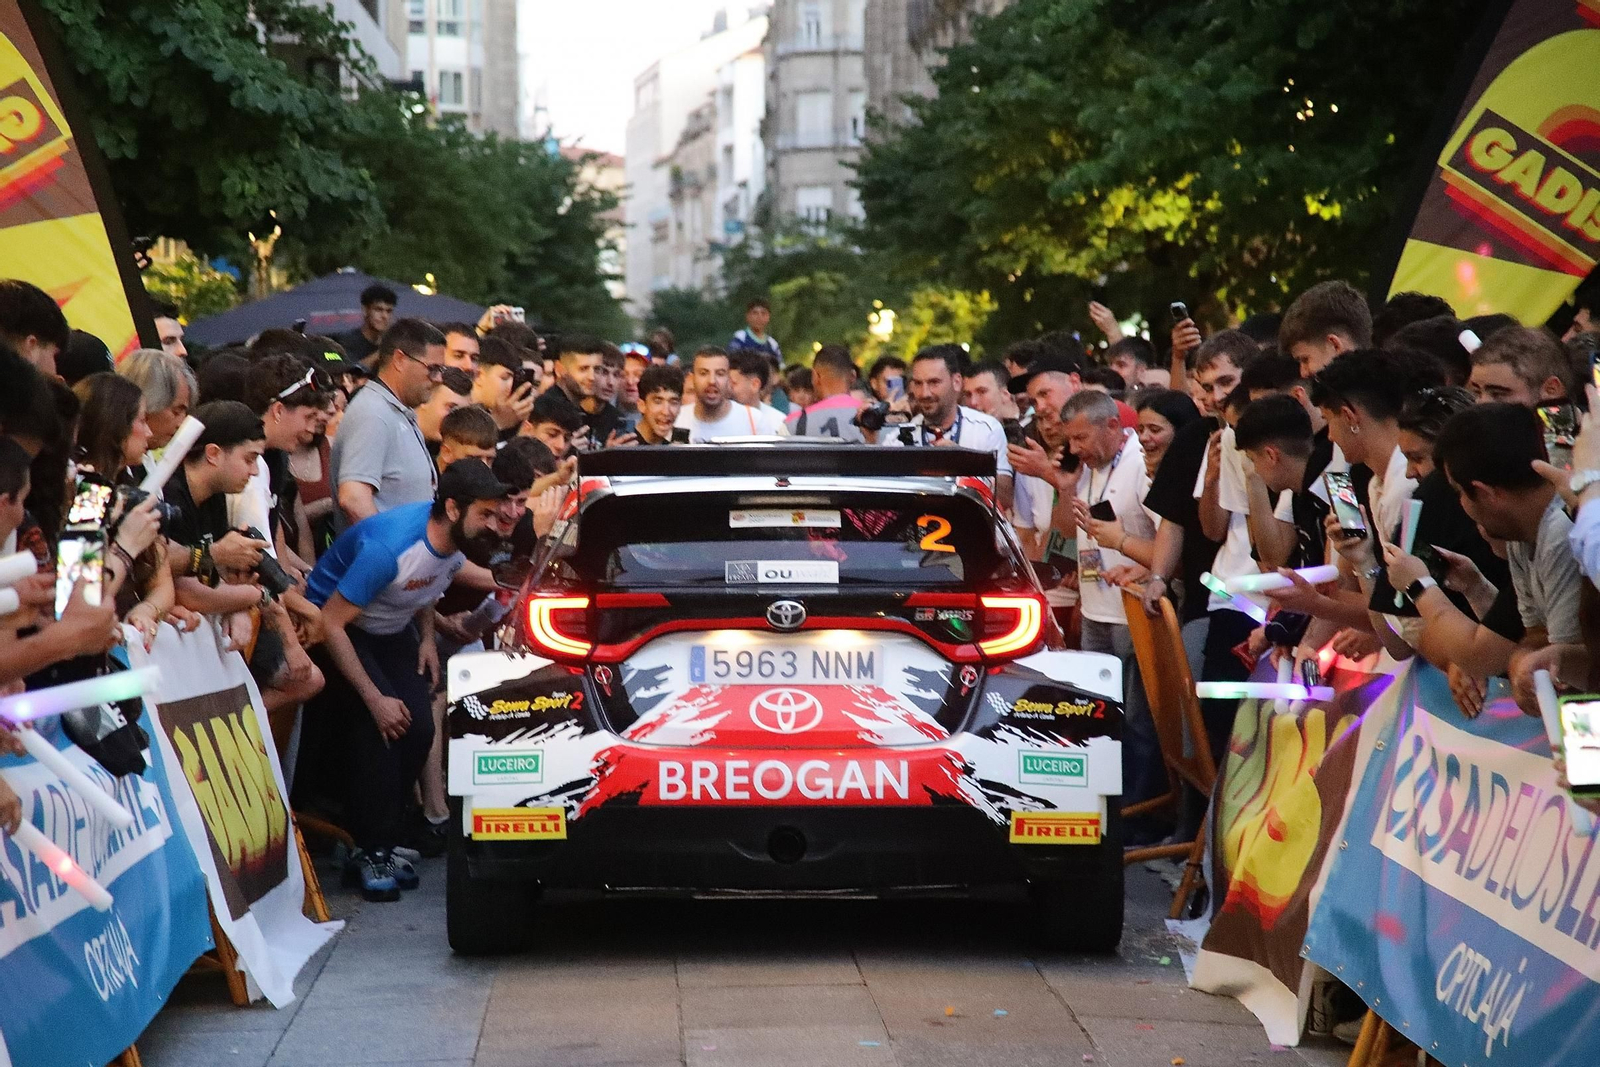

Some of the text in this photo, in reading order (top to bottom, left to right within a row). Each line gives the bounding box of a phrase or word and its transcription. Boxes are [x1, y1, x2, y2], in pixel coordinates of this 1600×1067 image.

[917, 515, 956, 553] 2
[713, 650, 875, 679] 5963 NNM
[531, 695, 573, 712] Sport
[570, 691, 584, 710] 2
[1055, 701, 1095, 718] Sport
[1093, 700, 1106, 718] 2
[480, 757, 536, 771] LUCEIRO
[1026, 758, 1081, 773] LUCEIRO
[658, 759, 909, 800] BREOGAN
[473, 814, 561, 833] PIRELLI
[1014, 818, 1100, 837] PIRELLI
